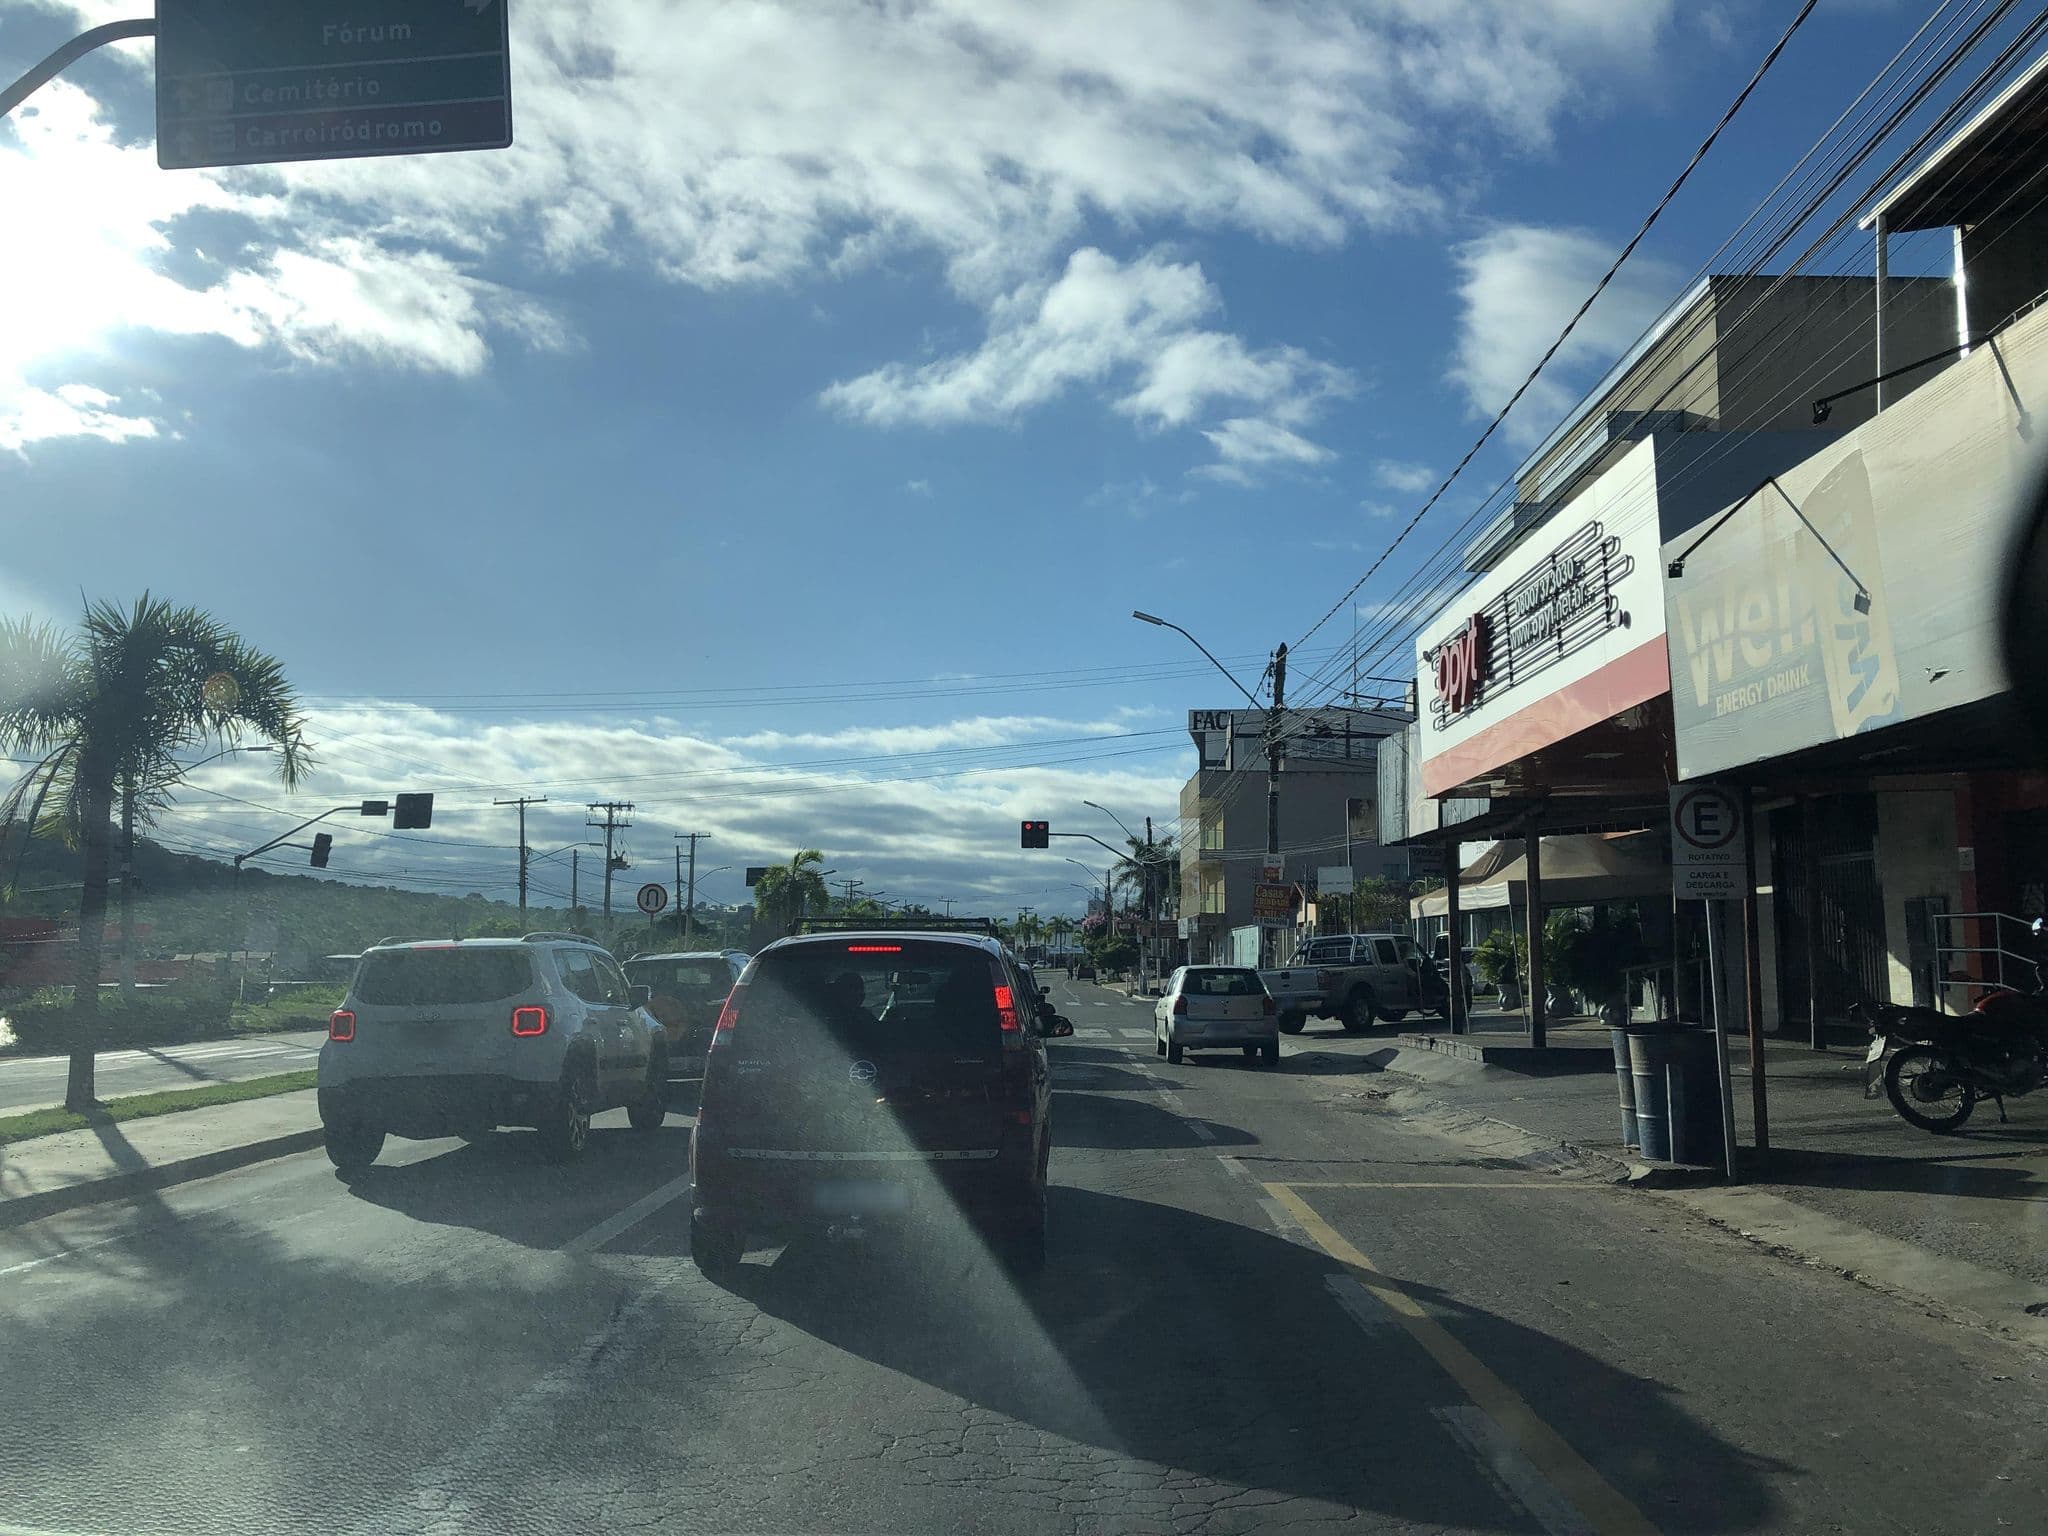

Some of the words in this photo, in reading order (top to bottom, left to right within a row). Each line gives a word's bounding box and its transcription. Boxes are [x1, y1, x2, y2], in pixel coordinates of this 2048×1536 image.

[321, 21, 413, 47] Fórum
[244, 75, 382, 105] Cemitério
[245, 117, 443, 148] Carreiródromo
[1438, 613, 1480, 711] opyt
[1716, 680, 1764, 717] ENERGY
[1767, 663, 1811, 700] DRINK
[1693, 801, 1721, 836] E
[1685, 881, 1736, 889] DESCARGA
[1689, 871, 1721, 879] CARGA
